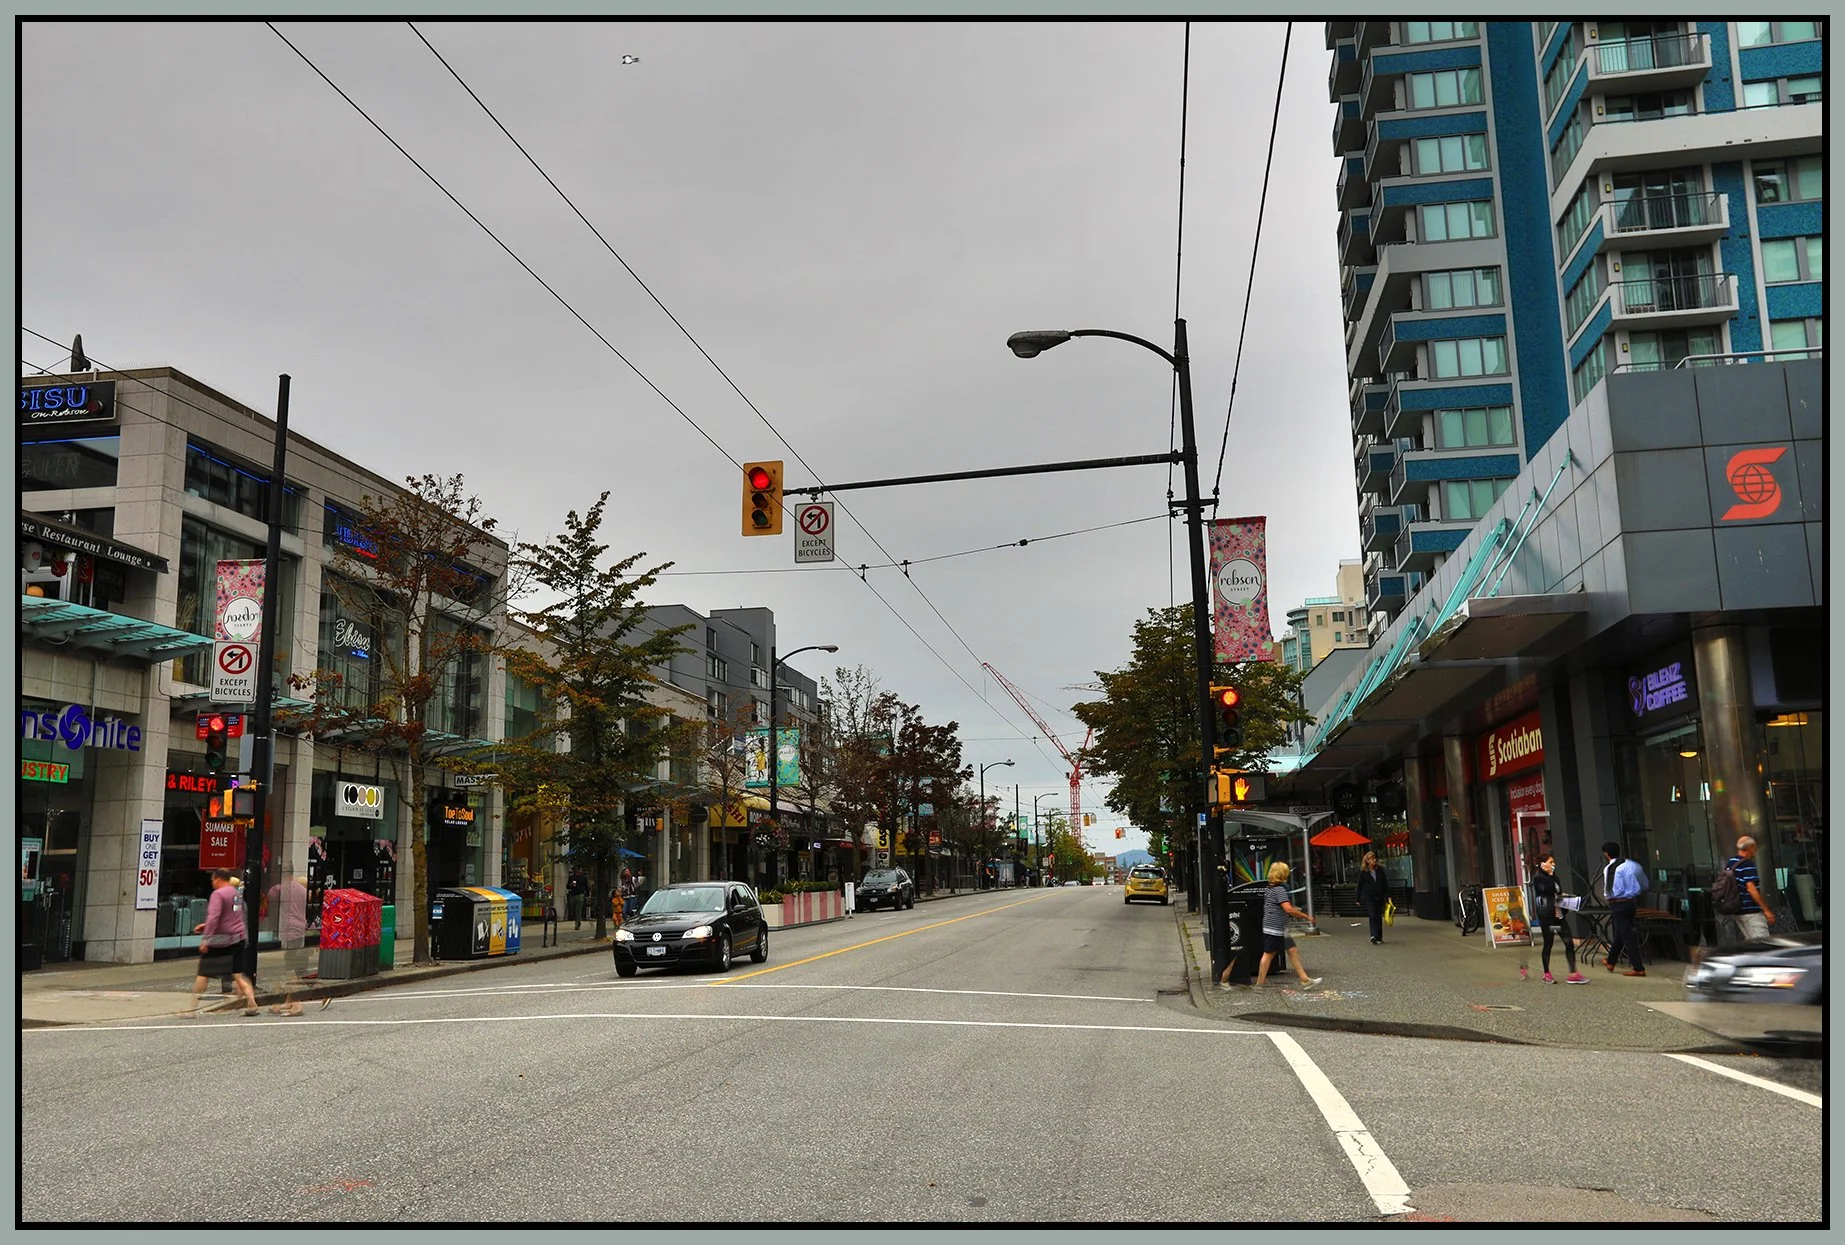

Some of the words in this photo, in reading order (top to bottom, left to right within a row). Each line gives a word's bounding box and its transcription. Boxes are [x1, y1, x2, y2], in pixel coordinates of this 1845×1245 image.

[42, 526, 101, 553] Restaurant
[107, 546, 142, 566] Lounge
[802, 539, 826, 548] EXCEPT
[799, 548, 831, 557] BICYCLES
[1220, 569, 1261, 586] robson
[220, 678, 248, 687] EXCEPT
[214, 687, 252, 697] BICYCLES
[1647, 681, 1688, 711] COFFEE
[168, 774, 177, 789] &
[180, 775, 217, 793] RILEY!
[205, 822, 234, 833] SUMMER
[144, 834, 160, 843] BUY
[211, 836, 228, 847] SALE
[145, 842, 157, 850] ONE
[143, 851, 158, 860] GET
